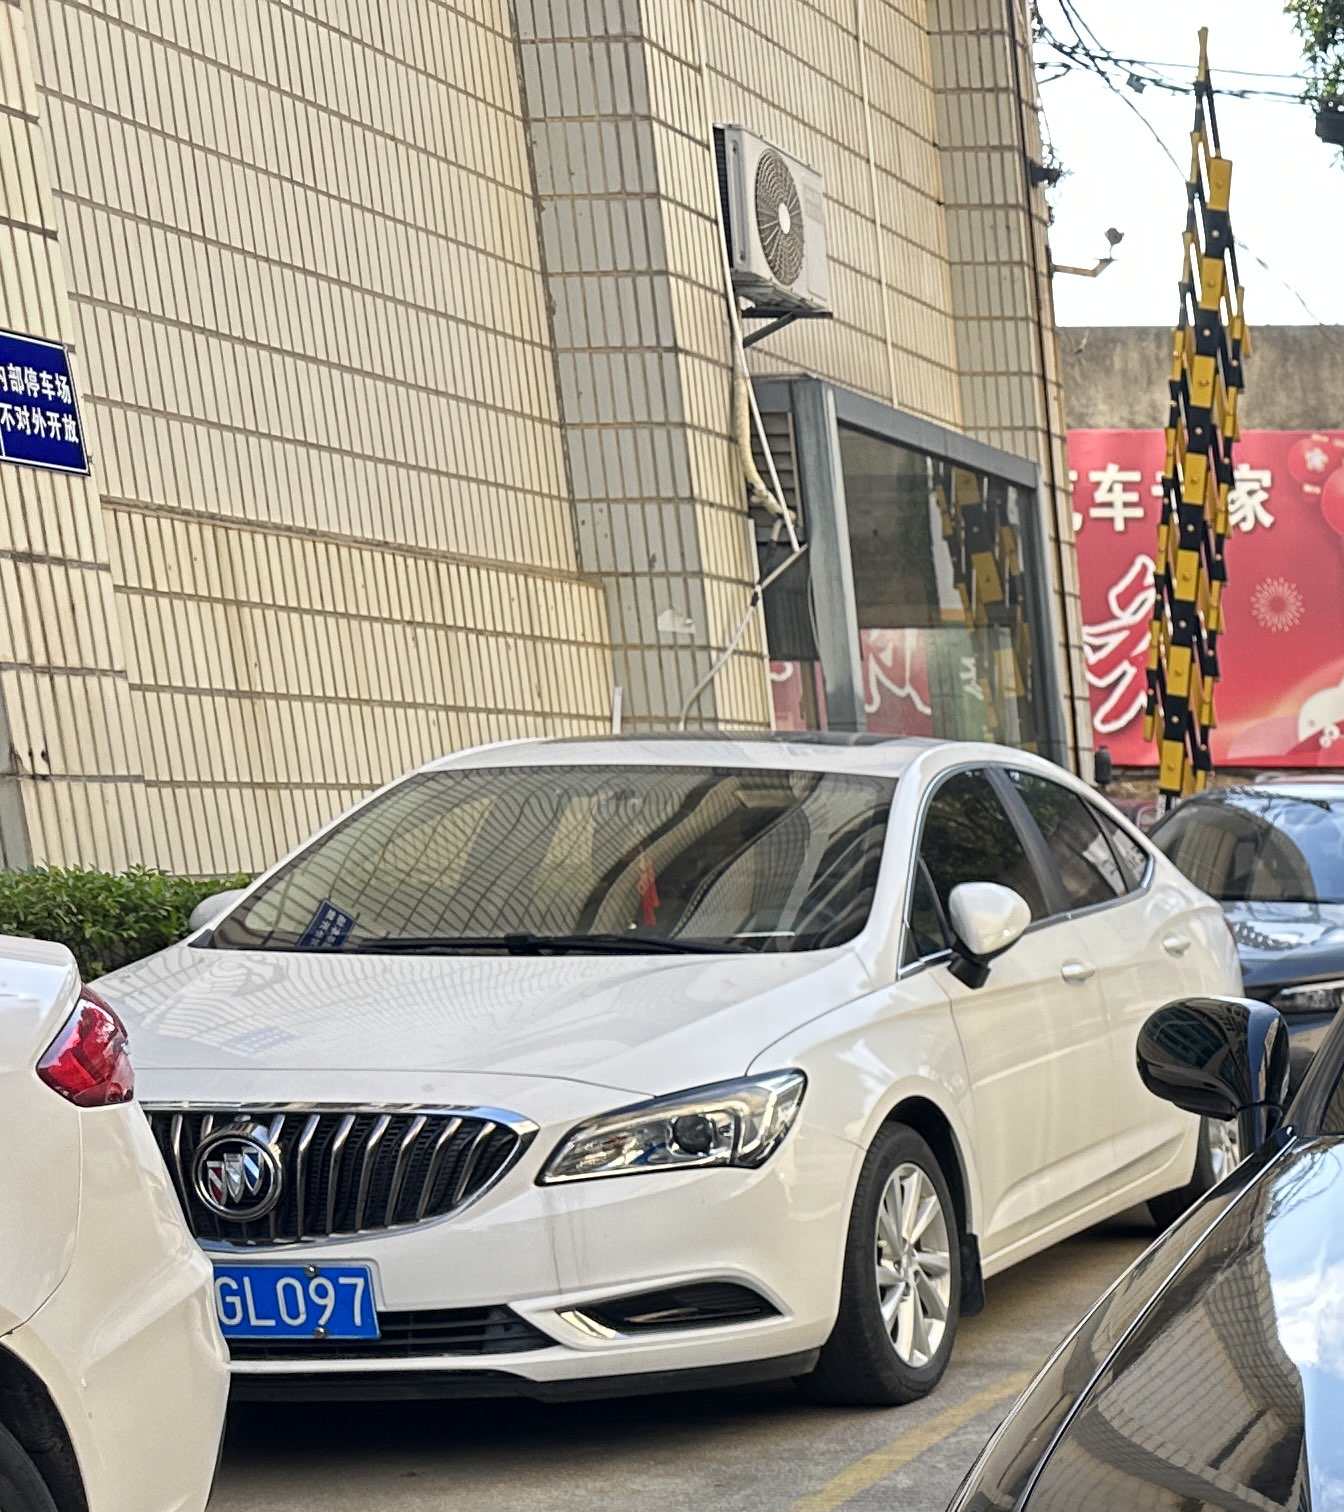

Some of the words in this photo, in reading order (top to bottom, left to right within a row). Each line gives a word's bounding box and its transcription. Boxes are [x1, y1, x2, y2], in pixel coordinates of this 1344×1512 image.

[0, 402, 79, 443] 不对外开放
[214, 1276, 365, 1327] GL097
